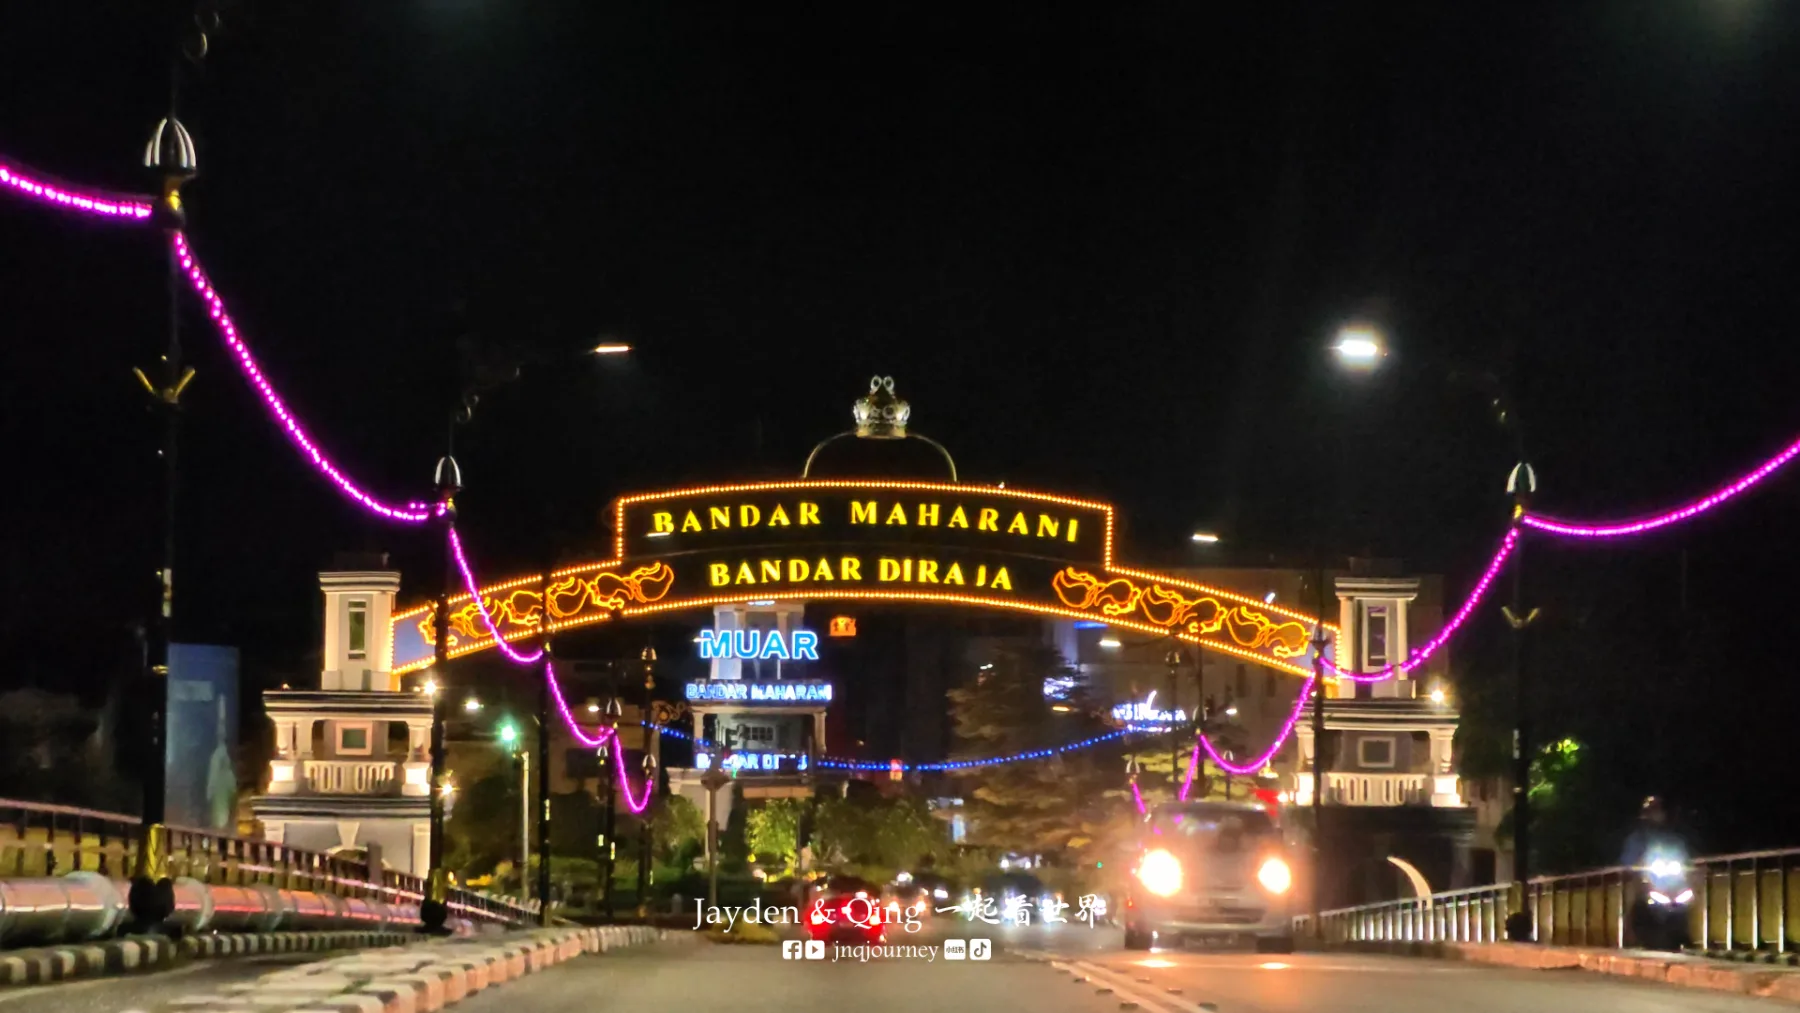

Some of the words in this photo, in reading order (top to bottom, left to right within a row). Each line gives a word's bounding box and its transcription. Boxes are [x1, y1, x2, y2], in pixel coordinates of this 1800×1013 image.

[653, 501, 821, 534] BANDAR
[850, 501, 1079, 542] MAHARANI
[709, 556, 862, 587] BANDAR
[878, 558, 1013, 590] DIRAJA
[700, 629, 819, 660] MUAR
[686, 683, 748, 700] BANDAR
[751, 684, 833, 700] MAHARANI
